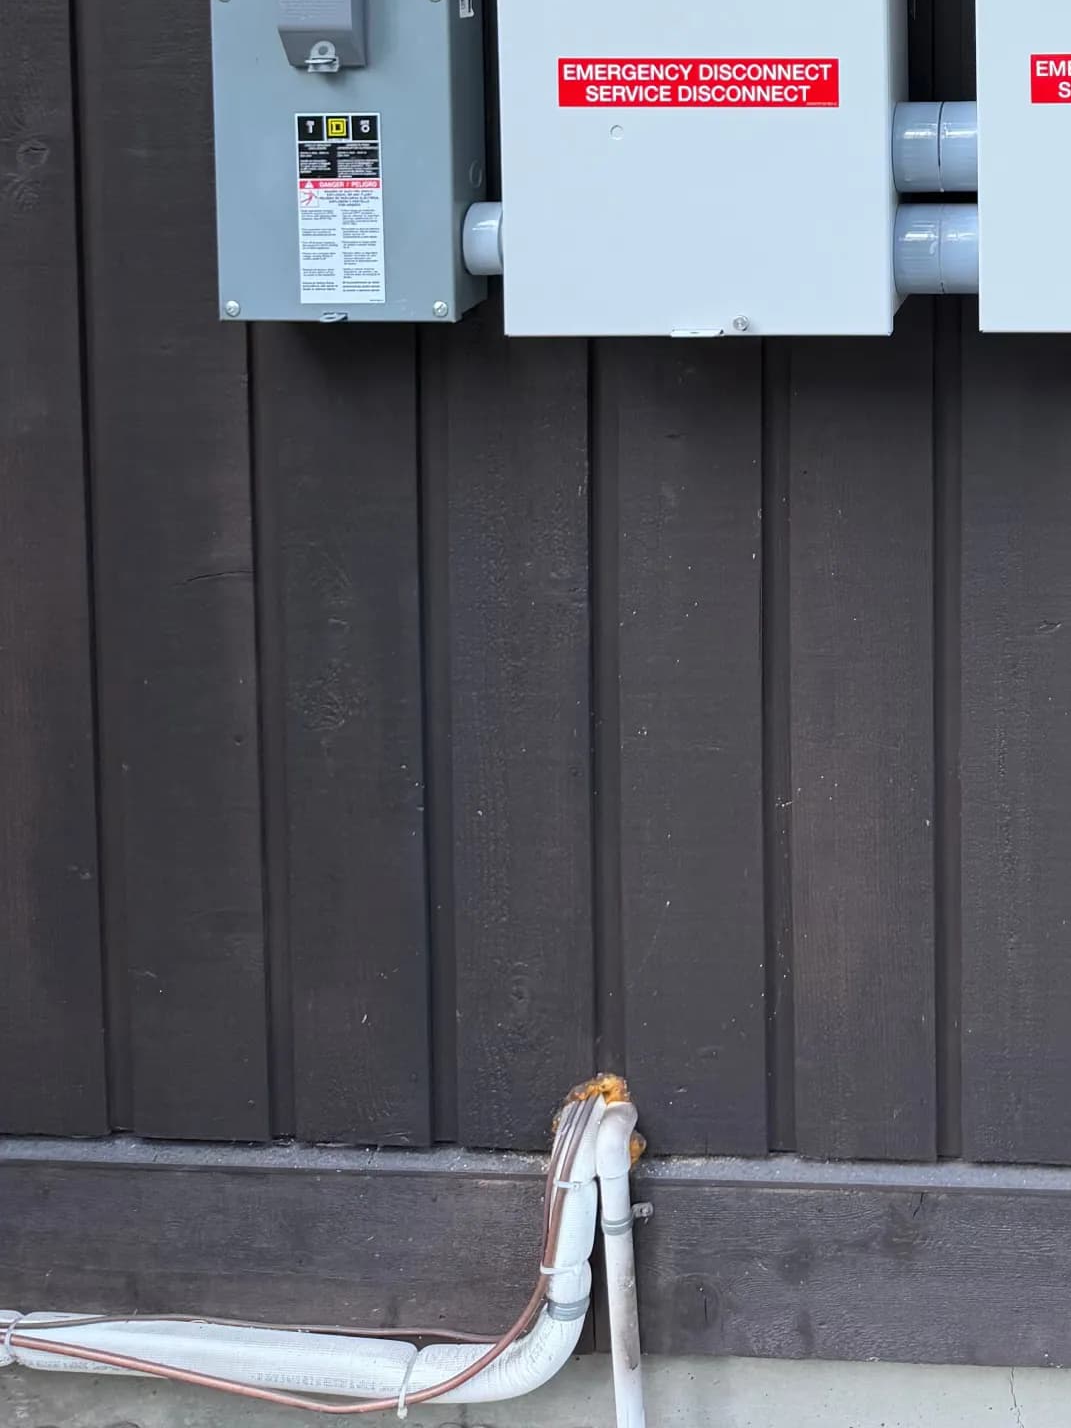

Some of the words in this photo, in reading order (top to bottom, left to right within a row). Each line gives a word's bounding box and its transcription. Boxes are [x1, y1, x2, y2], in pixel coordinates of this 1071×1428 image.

[563, 63, 693, 81] EMERGENCY
[699, 63, 832, 81] DISCONNECT
[585, 85, 672, 102] SERVICE
[678, 85, 811, 102] DISCONNECT
